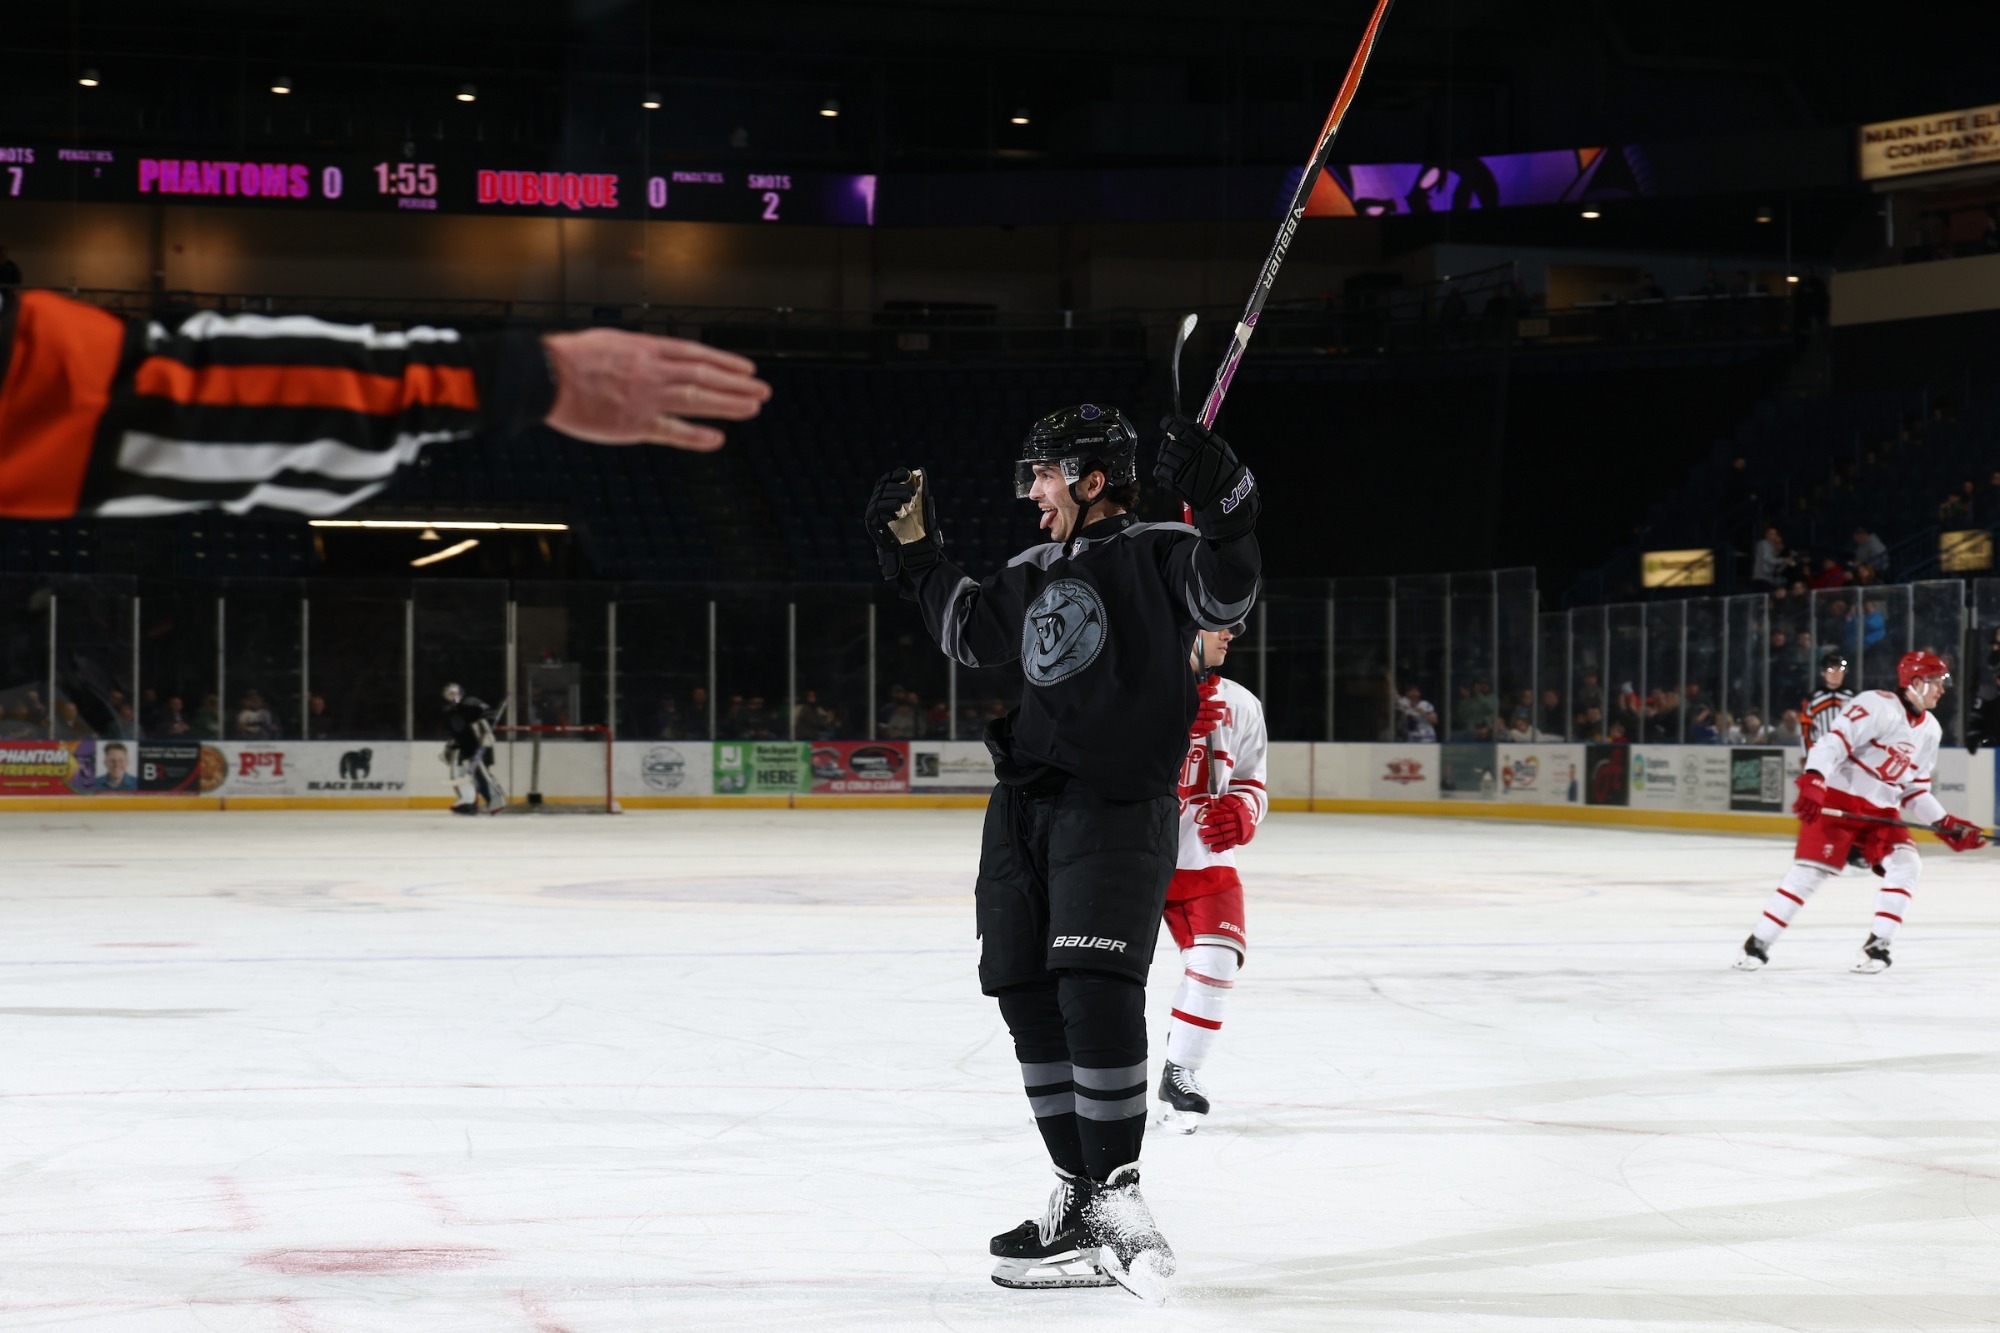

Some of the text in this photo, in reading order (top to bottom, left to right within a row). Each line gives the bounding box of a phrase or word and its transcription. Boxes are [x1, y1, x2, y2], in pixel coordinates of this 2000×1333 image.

[1865, 124, 1919, 143] MAIN
[1925, 117, 1967, 135] LITE
[0, 148, 35, 163] HOTS
[7, 166, 24, 197] 7
[138, 158, 343, 199] PHANTOMS 0
[373, 162, 438, 195] 1:55
[748, 174, 792, 190] SHOTS
[477, 170, 667, 210] DUBUQUE 0
[761, 192, 780, 221] 2
[1844, 704, 1869, 723] 17
[0, 748, 69, 764] PHANTOM
[307, 781, 405, 791] BLACK BEAR TV
[757, 769, 798, 785] HERE
[1052, 935, 1127, 953] BAUER
[1052, 1227, 1076, 1243] AUER
